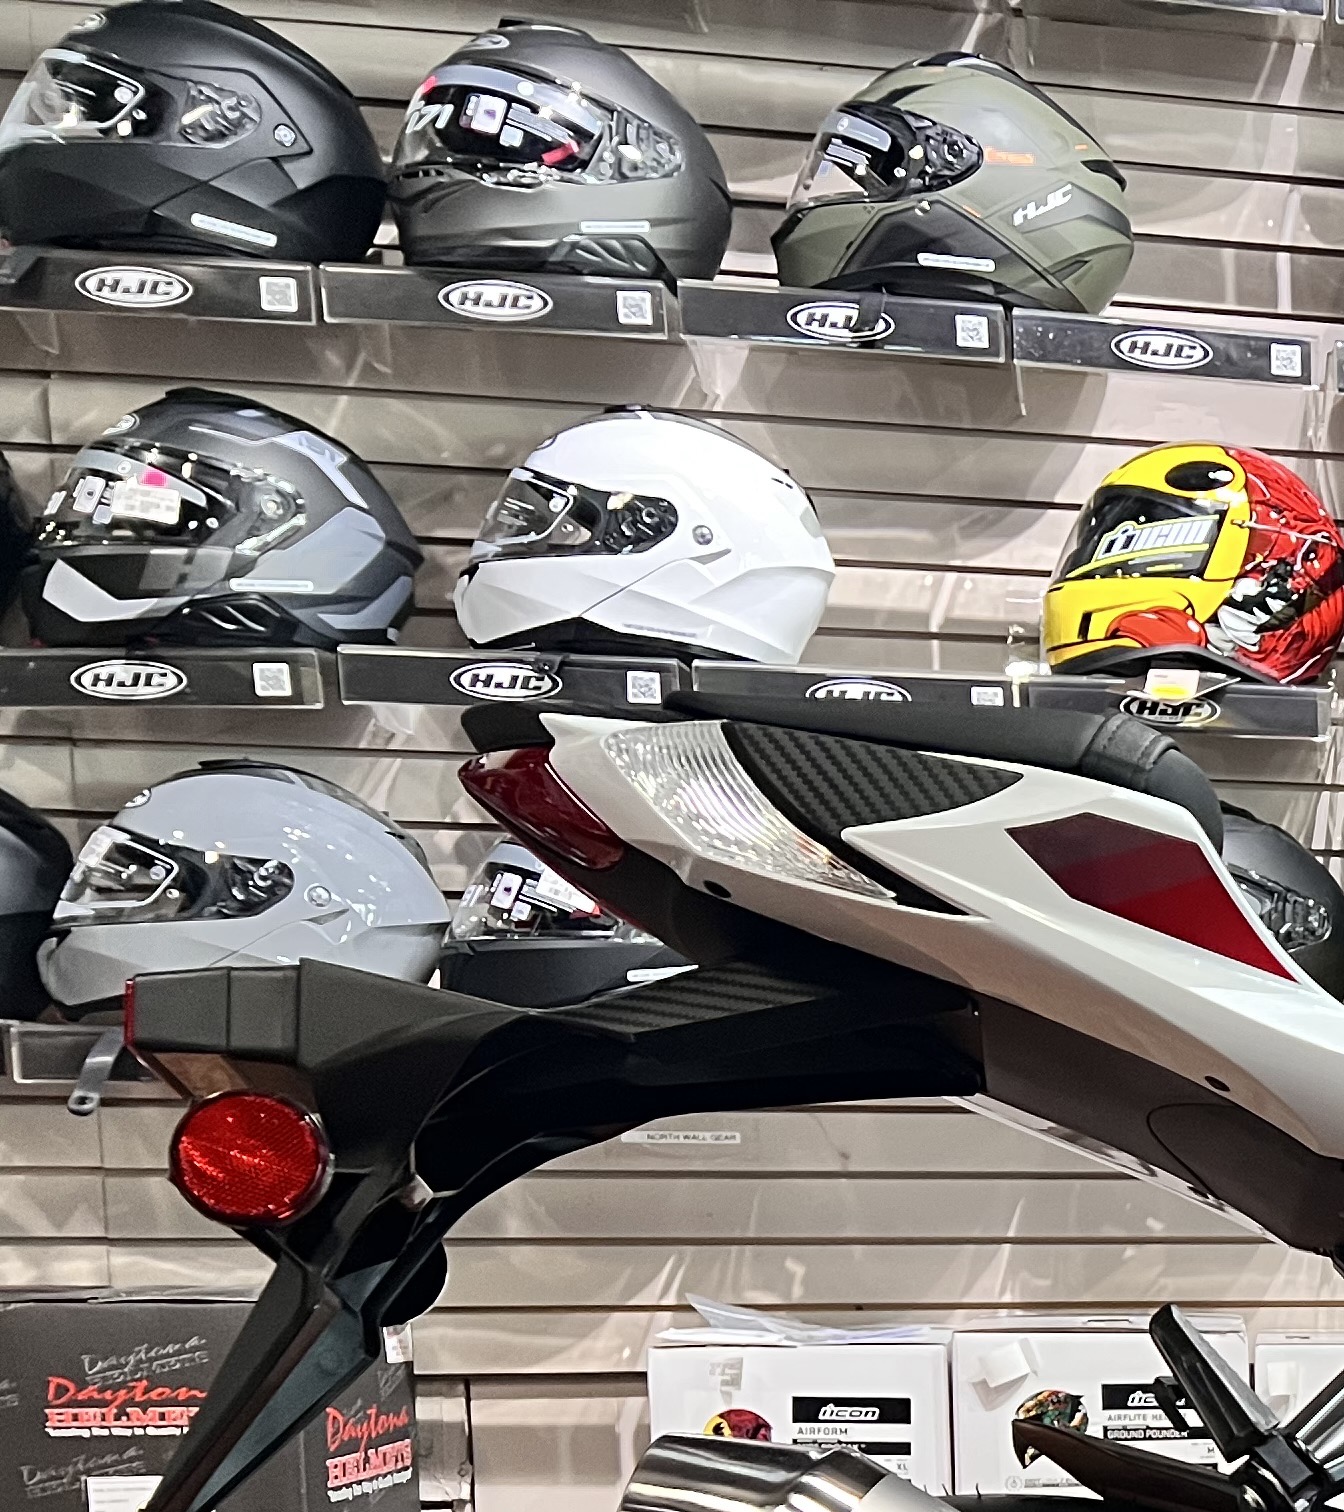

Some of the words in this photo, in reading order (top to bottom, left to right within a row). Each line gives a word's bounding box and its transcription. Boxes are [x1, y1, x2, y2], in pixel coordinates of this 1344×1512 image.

[1012, 183, 1073, 226] HJC
[683, 1133, 705, 1141] WALL
[711, 1133, 737, 1141] GEAR
[46, 1375, 208, 1410] Dayton
[1107, 1413, 1148, 1423] AIRFLITE
[325, 1403, 410, 1453] Daytona
[797, 1426, 848, 1436] AIRFORM
[1107, 1429, 1144, 1439] GROUND
